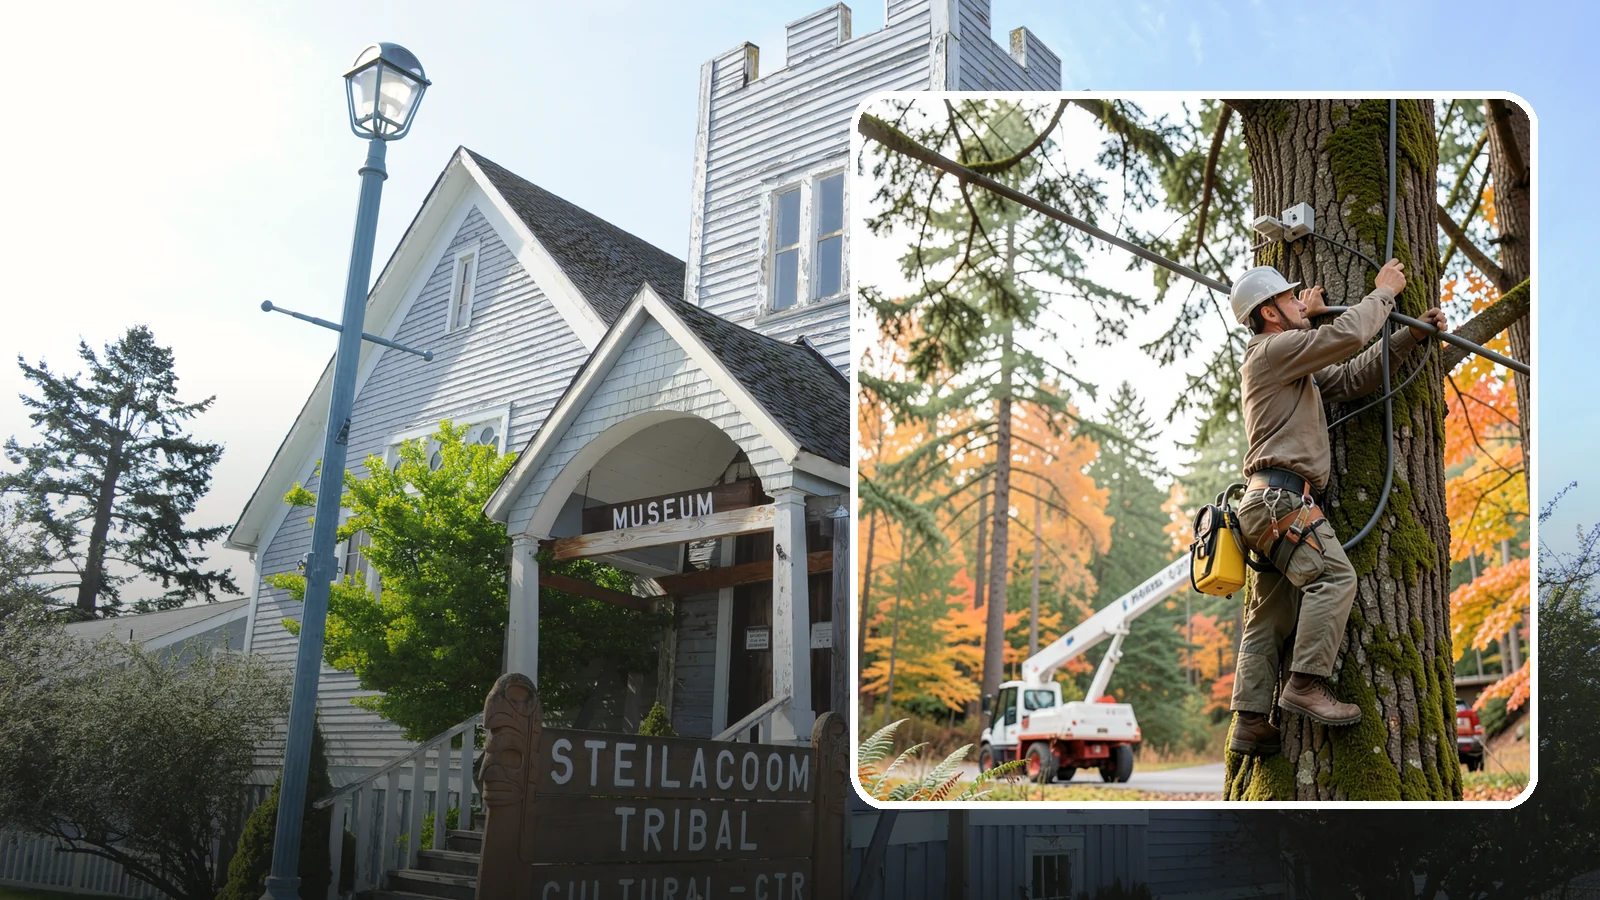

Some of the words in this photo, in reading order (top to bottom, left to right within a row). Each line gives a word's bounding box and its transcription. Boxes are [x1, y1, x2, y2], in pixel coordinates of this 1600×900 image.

[613, 492, 713, 530] MUSEUM
[550, 738, 809, 792] STEILACOOM
[615, 807, 758, 851] TRIBAL
